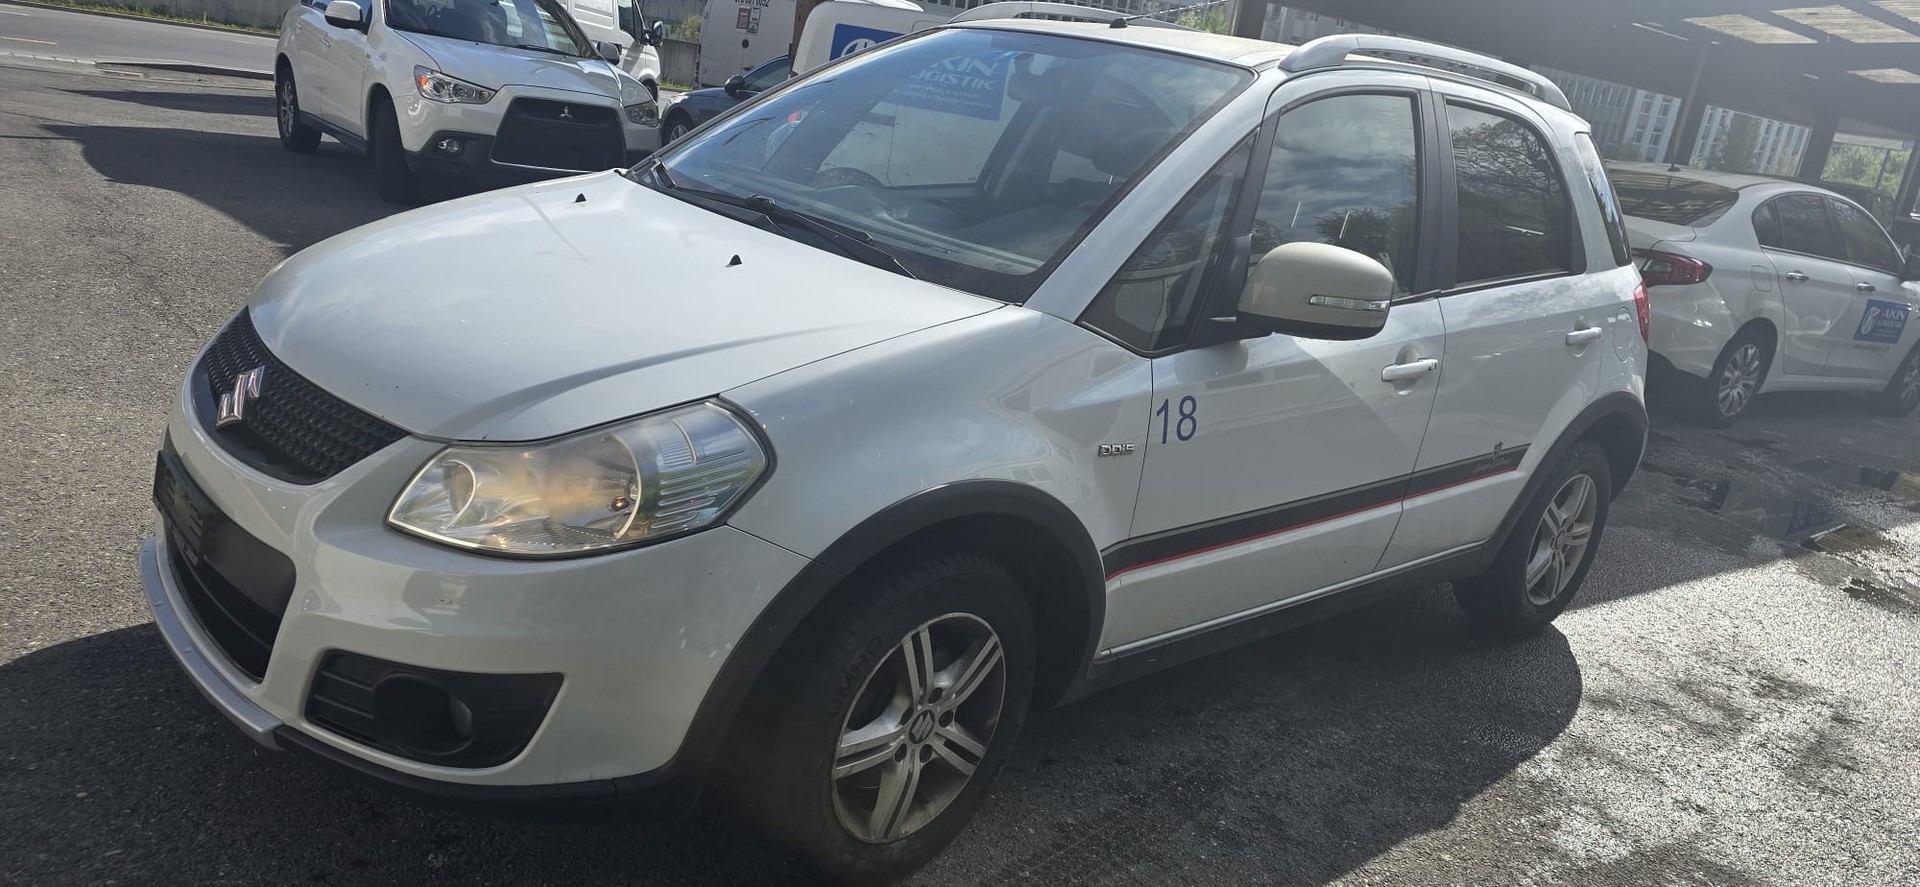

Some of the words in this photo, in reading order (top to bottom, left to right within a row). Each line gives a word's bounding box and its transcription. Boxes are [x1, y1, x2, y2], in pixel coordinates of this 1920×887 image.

[928, 56, 998, 76] KIN
[911, 69, 997, 90] GISTIK
[1156, 395, 1197, 444] 18
